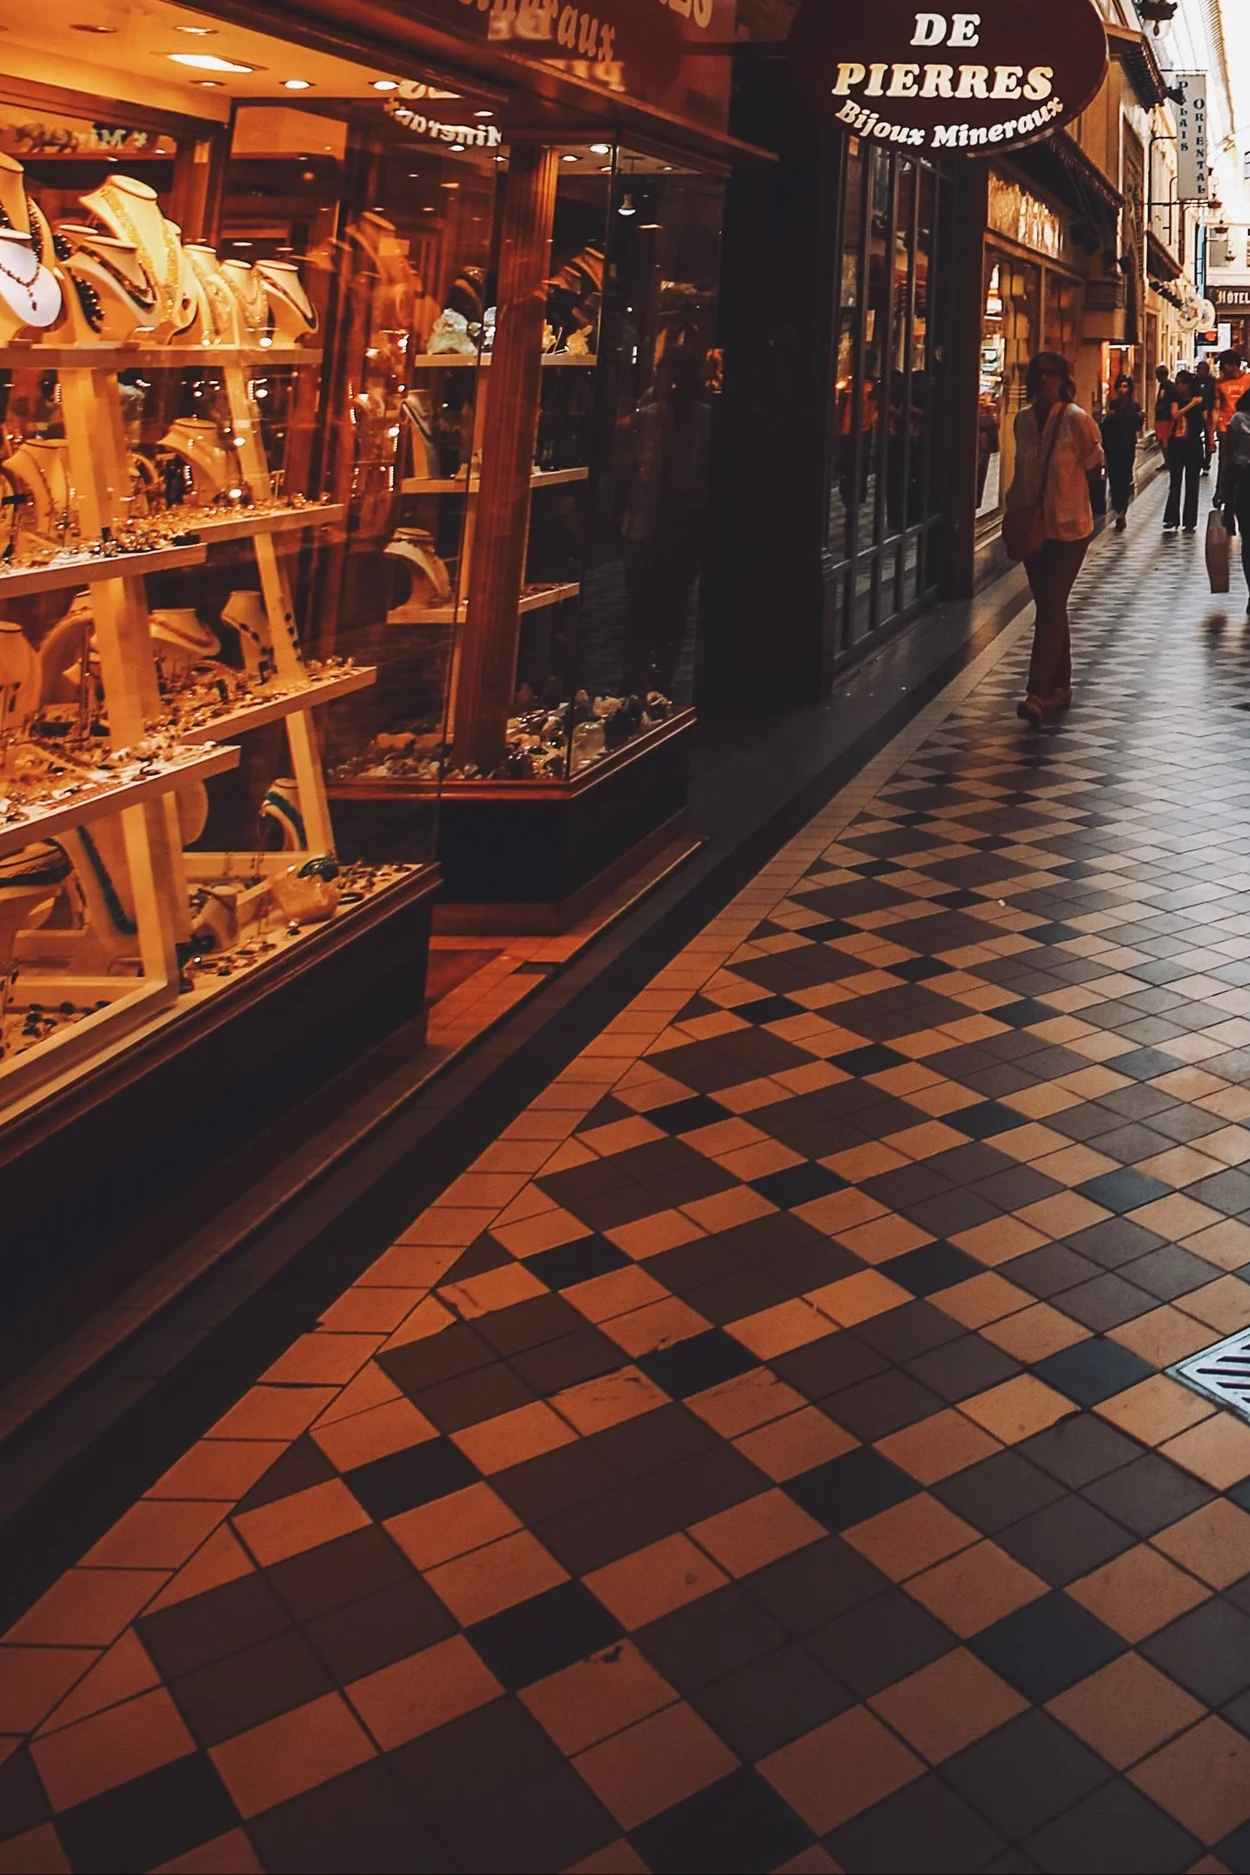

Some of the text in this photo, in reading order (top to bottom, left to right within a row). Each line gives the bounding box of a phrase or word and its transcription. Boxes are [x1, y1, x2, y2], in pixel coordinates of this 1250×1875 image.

[910, 12, 982, 48] DE
[831, 62, 1054, 102] PIERRES
[835, 96, 1064, 149] Bijoux Mineraux
[1192, 97, 1206, 195] ORIENTAL
